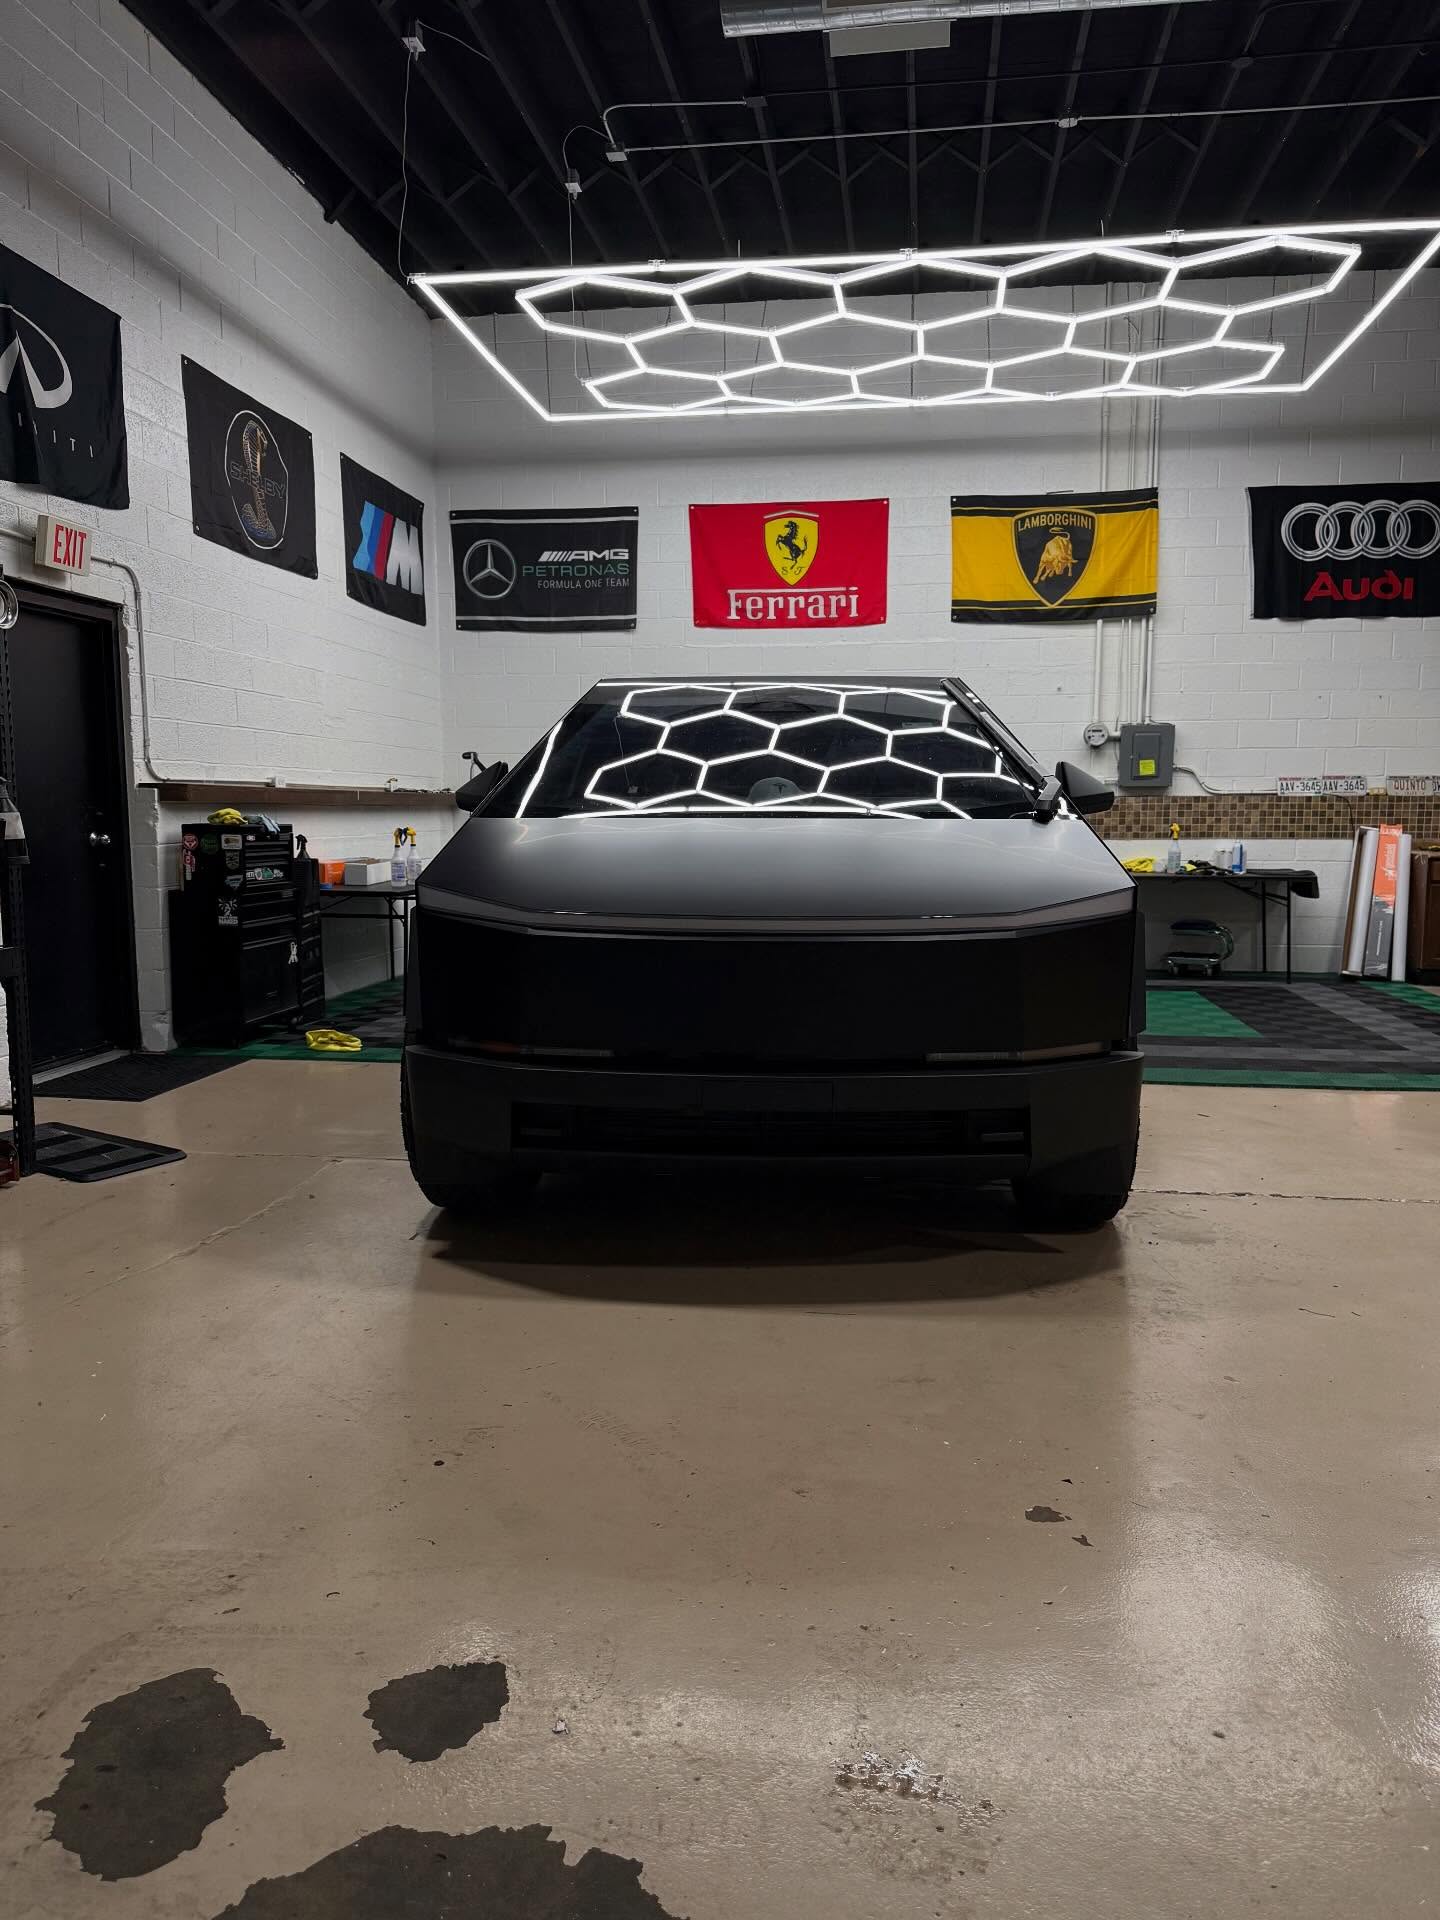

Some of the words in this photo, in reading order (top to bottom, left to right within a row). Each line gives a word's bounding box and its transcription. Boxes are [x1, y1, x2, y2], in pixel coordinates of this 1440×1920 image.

[1017, 513, 1092, 532] LAMBORGHINI
[53, 523, 87, 569] EXIT
[568, 548, 629, 561] AMG
[522, 562, 630, 577] PETRONAS
[537, 578, 582, 590] FORMULA
[584, 577, 603, 589] ONE
[606, 576, 630, 588] TEAM
[1304, 569, 1414, 600] Audi
[727, 586, 859, 621] Ferrari
[1280, 780, 1322, 792] AAV-3645
[1322, 779, 1365, 791] AAV-3645
